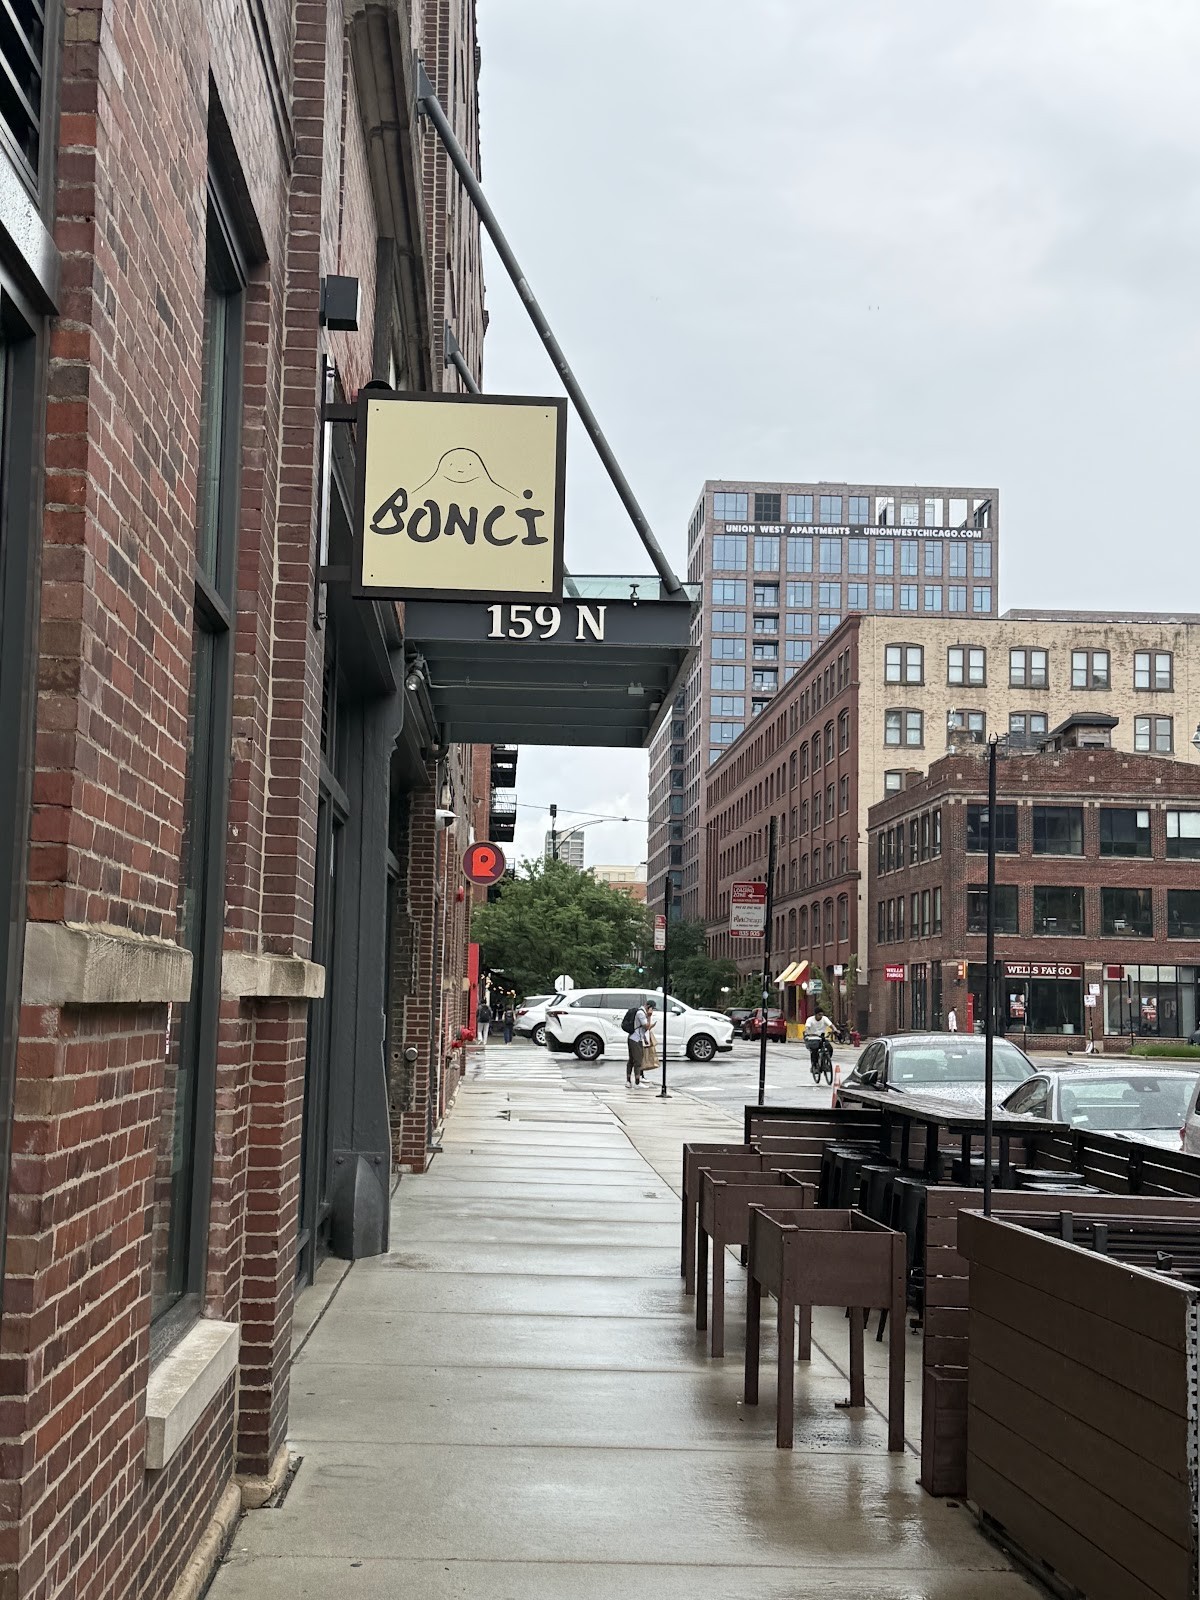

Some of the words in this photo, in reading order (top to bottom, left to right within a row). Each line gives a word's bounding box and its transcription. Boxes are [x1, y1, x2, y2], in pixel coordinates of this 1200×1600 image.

[369, 487, 549, 546] BONCI
[725, 524, 756, 533] UNION
[760, 525, 786, 534] WEST
[790, 526, 851, 535] APARTMENTS
[863, 527, 982, 538] UNIONWESTCHICAGO.COM
[486, 605, 562, 640] 159
[575, 605, 607, 641] N
[1007, 965, 1039, 975] WELLS
